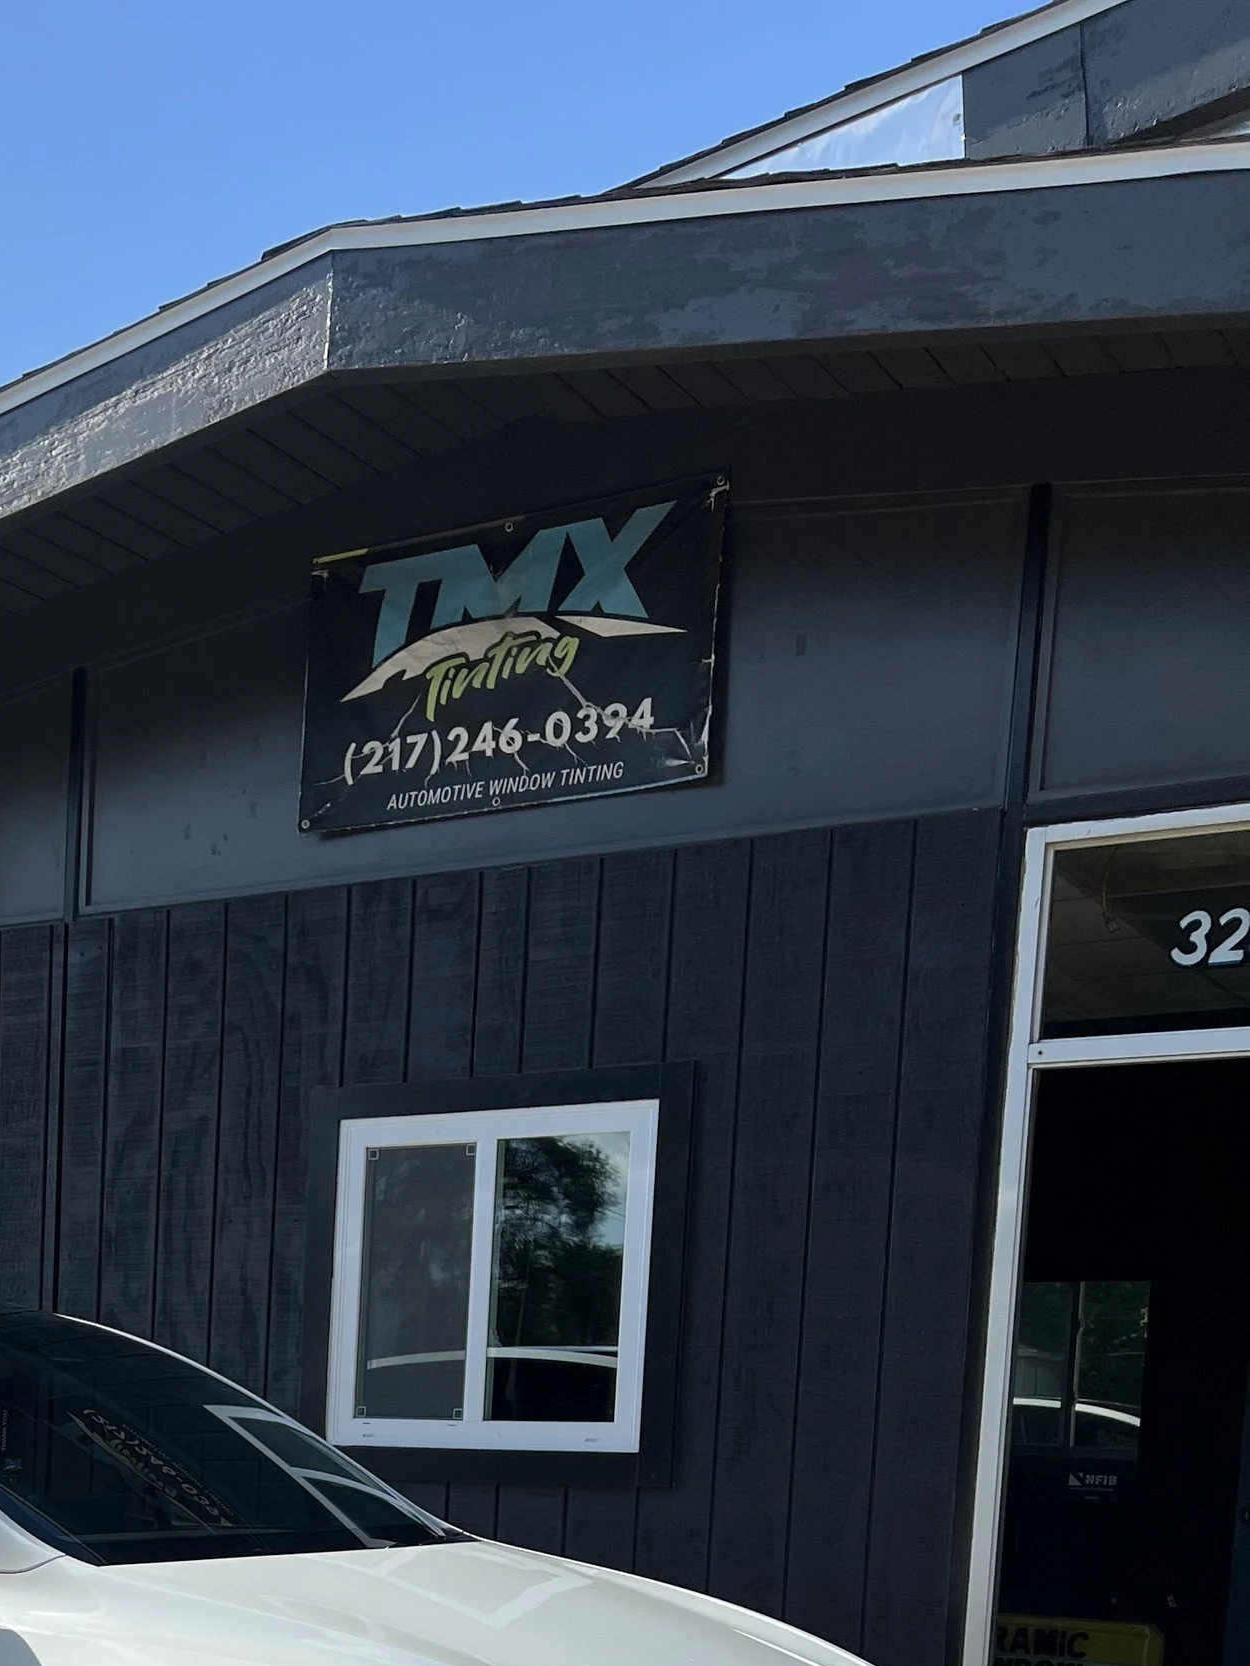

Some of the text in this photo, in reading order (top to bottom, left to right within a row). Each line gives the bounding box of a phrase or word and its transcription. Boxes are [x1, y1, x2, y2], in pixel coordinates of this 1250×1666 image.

[358, 500, 677, 669] TMX
[425, 633, 580, 721] Tinting
[343, 696, 655, 786] (217)246-0394
[387, 761, 624, 810] AUTOMOTIVE WINDOW TINTING
[1169, 906, 1250, 967] 32
[1085, 1474, 1118, 1486] NFIB
